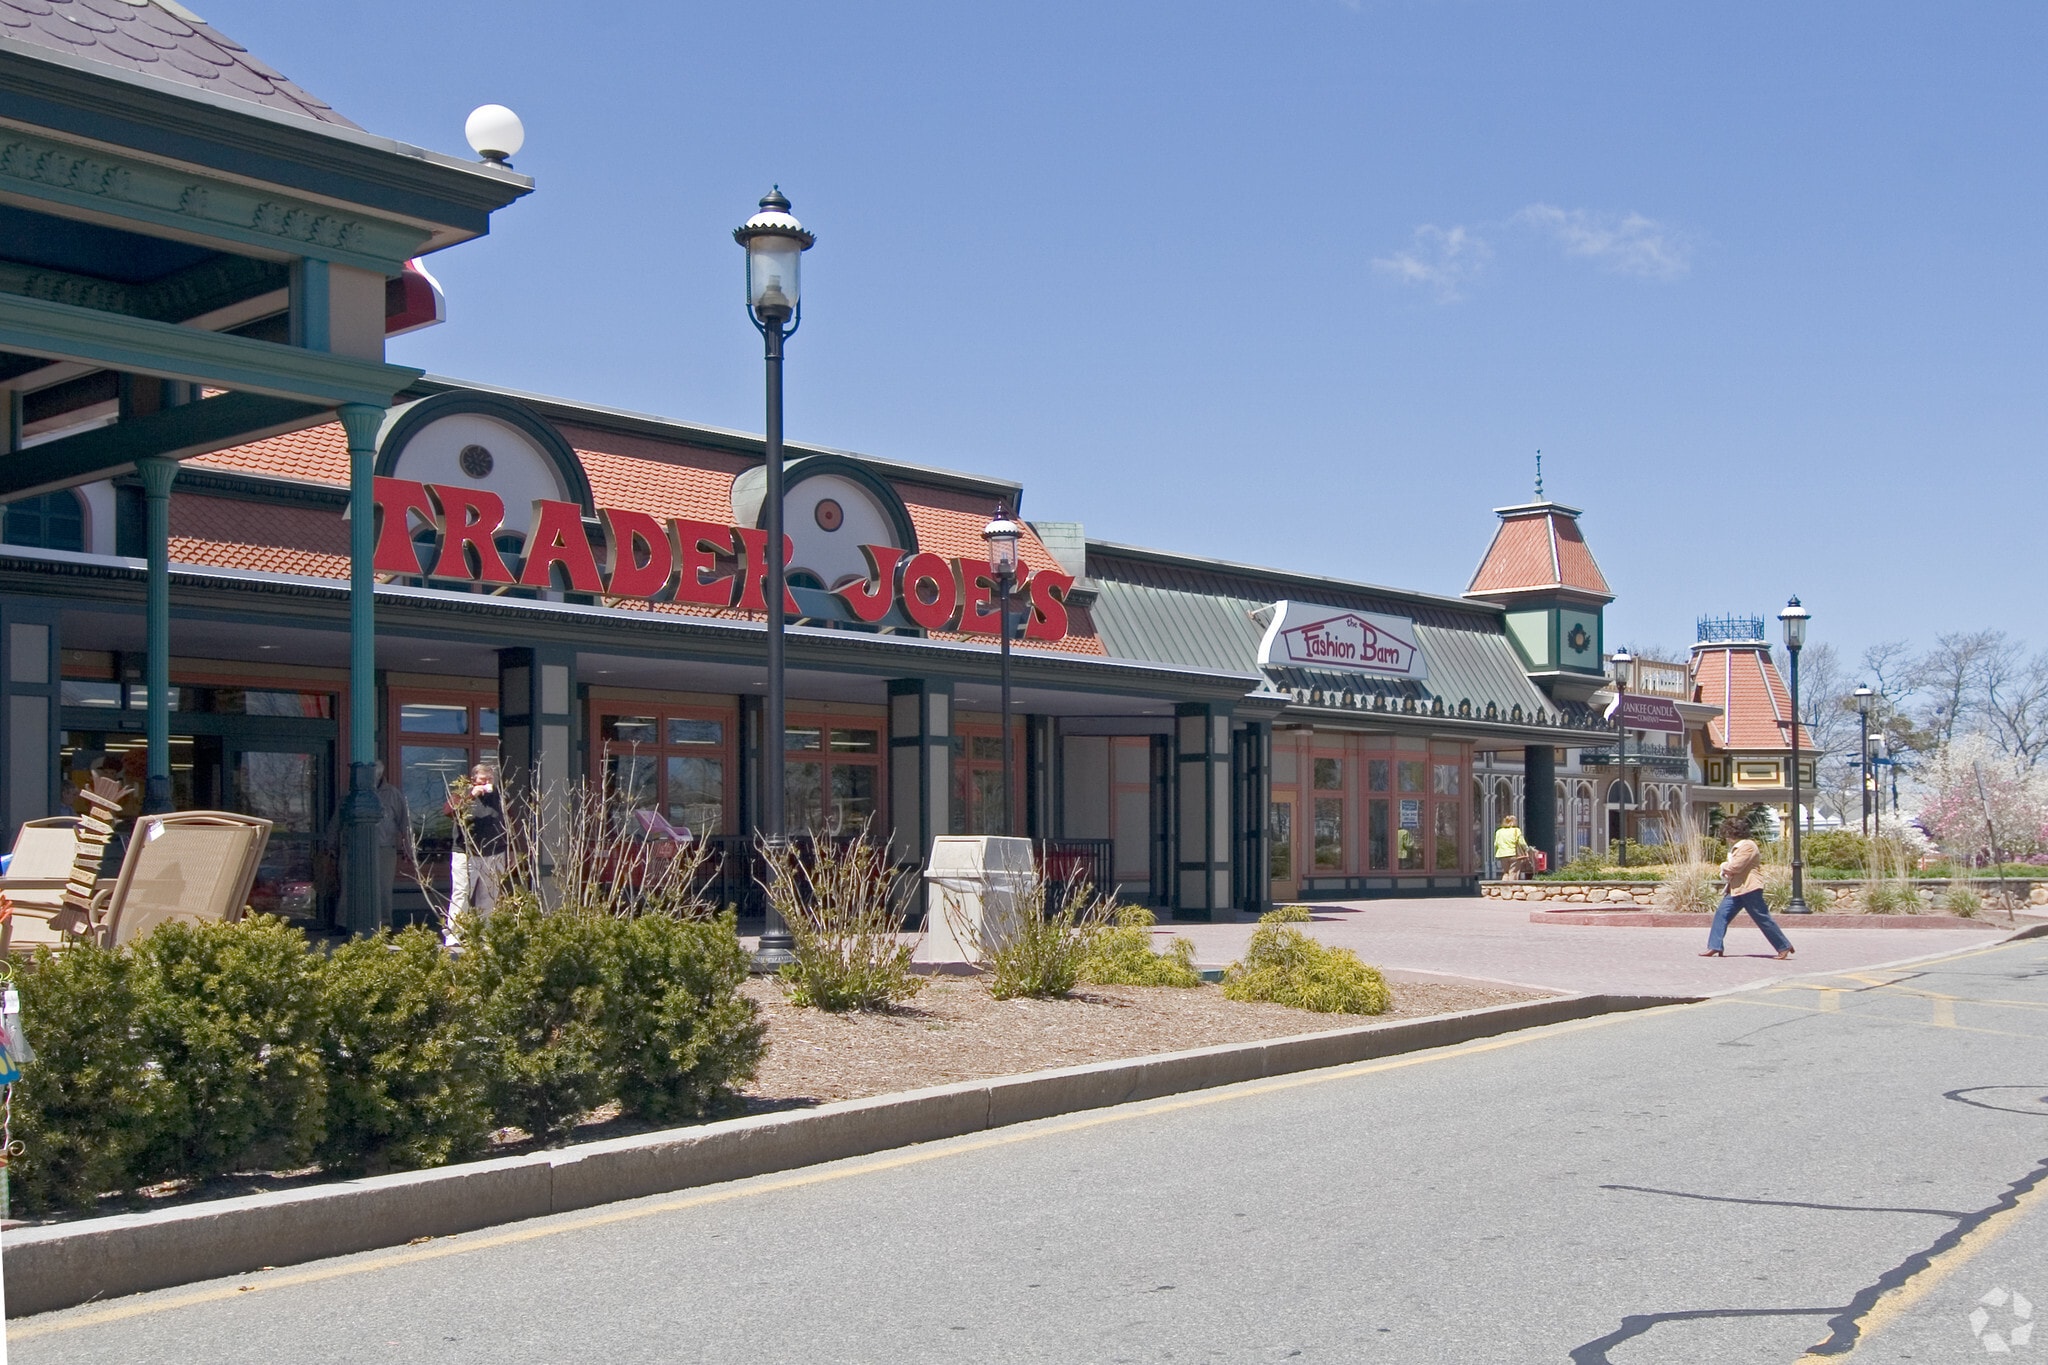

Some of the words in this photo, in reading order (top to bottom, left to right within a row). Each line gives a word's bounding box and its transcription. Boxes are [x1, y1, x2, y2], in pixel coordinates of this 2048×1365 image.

[372, 476, 802, 615] TRADER
[829, 544, 1075, 642] JOE'S
[1346, 618, 1358, 628] the
[1301, 625, 1355, 659] Fashion
[1359, 623, 1399, 664] Barn
[1647, 704, 1674, 717] CANDLE
[1637, 714, 1660, 723] COMPANY
